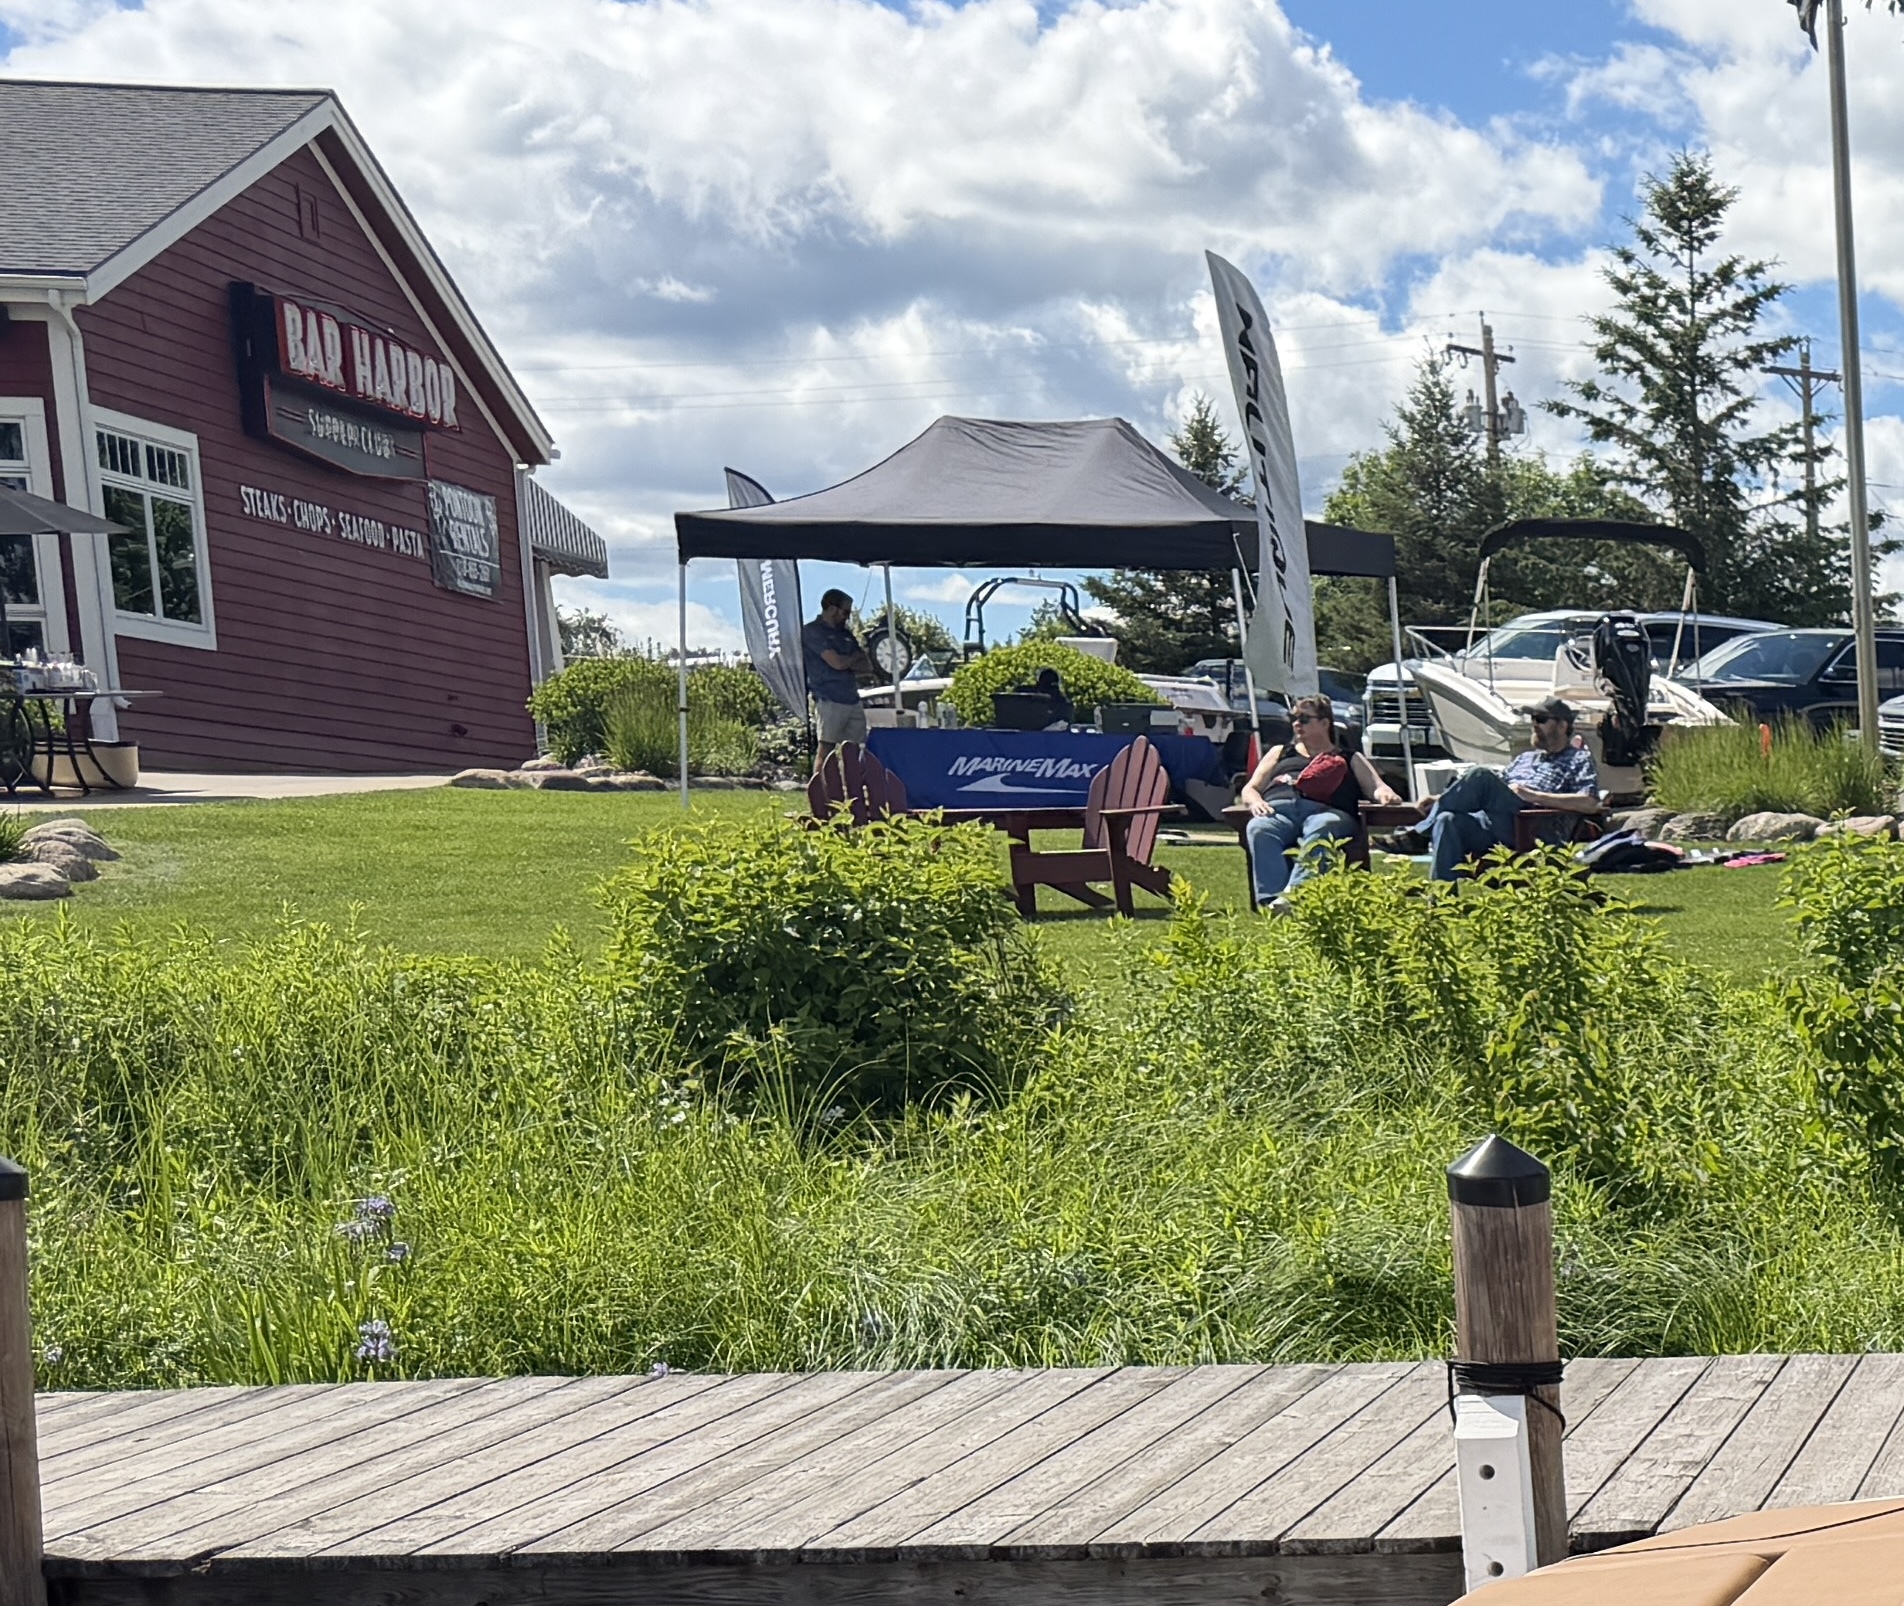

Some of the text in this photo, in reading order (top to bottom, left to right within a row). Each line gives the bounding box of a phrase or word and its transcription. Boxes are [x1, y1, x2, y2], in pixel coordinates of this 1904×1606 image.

[283, 302, 460, 432] BAR HARBOR
[241, 485, 425, 559] STEAKS CHOPS SEAFOOD PASTA
